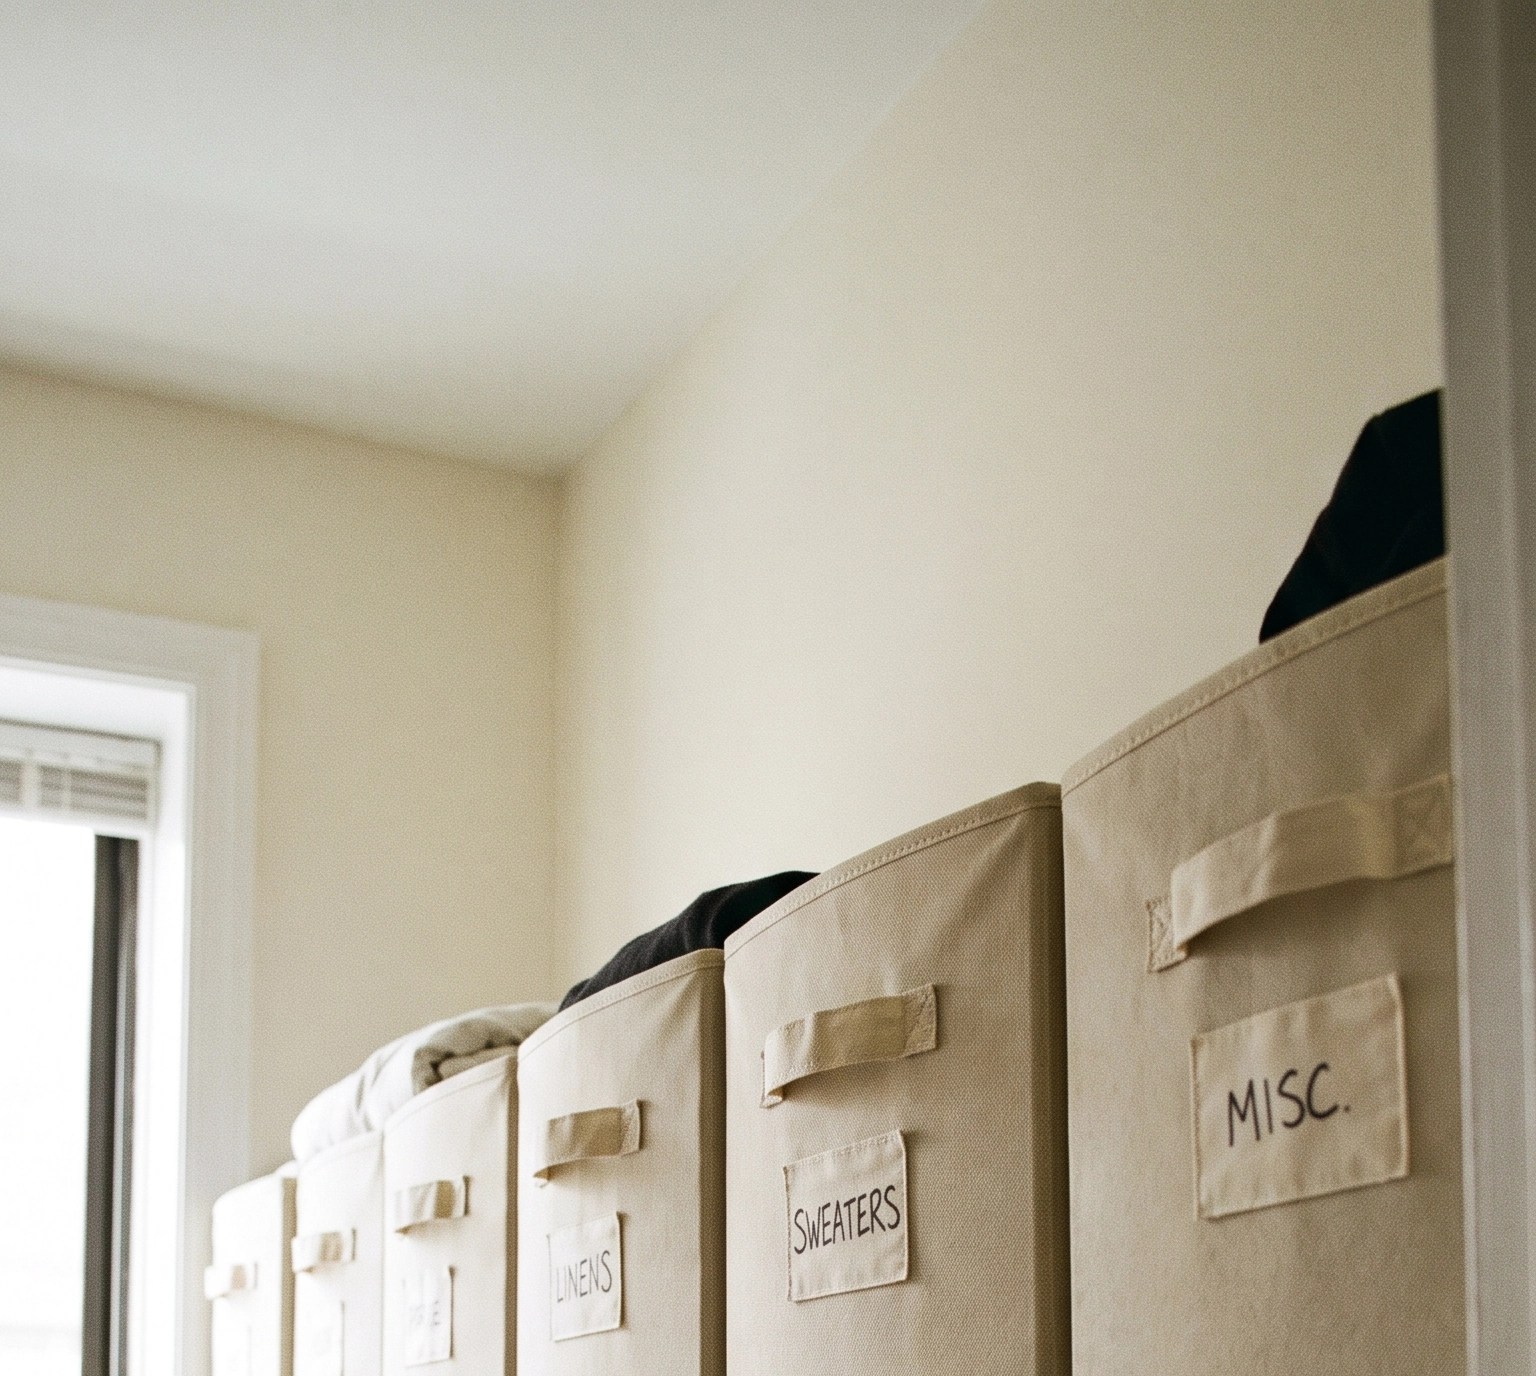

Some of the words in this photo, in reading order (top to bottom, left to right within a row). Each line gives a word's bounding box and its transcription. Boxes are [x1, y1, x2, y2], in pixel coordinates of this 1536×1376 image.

[1227, 1061, 1350, 1148] MISC.
[793, 1184, 901, 1255] SWEATERS
[556, 1249, 613, 1303] LINENS
